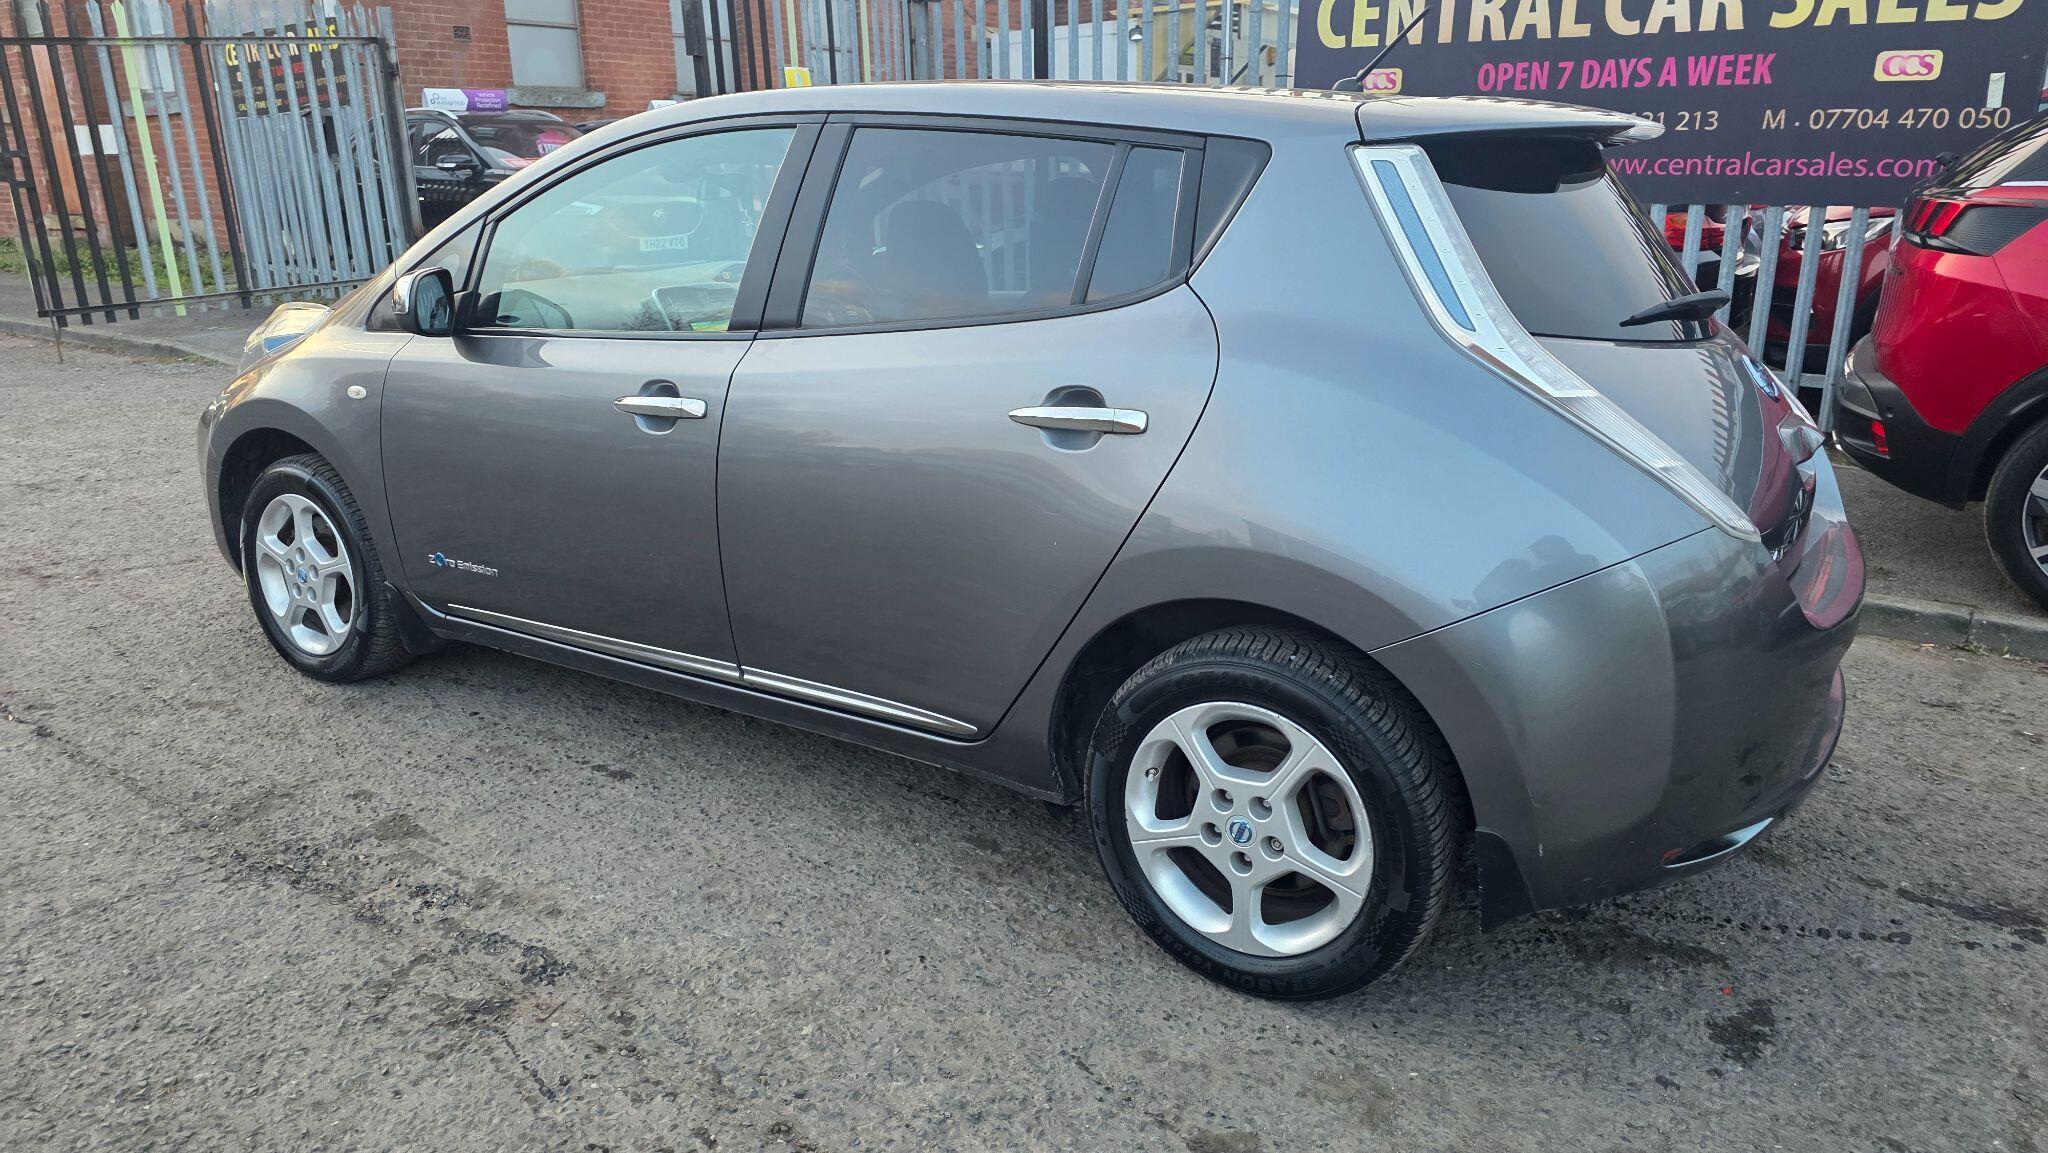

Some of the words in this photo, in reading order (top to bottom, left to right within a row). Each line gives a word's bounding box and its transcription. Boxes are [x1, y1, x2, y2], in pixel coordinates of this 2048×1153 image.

[1317, 0, 1591, 48] CENTRAL
[1478, 60, 1549, 92] OPEN
[1557, 61, 1574, 90] 7
[1580, 57, 1652, 90] DAYS
[1657, 57, 1676, 87] A
[1688, 53, 1776, 86] WEEK
[1674, 110, 1719, 131] 213
[1809, 107, 1890, 130] 07704
[1898, 107, 1950, 129] 470
[1959, 106, 2011, 129] 050
